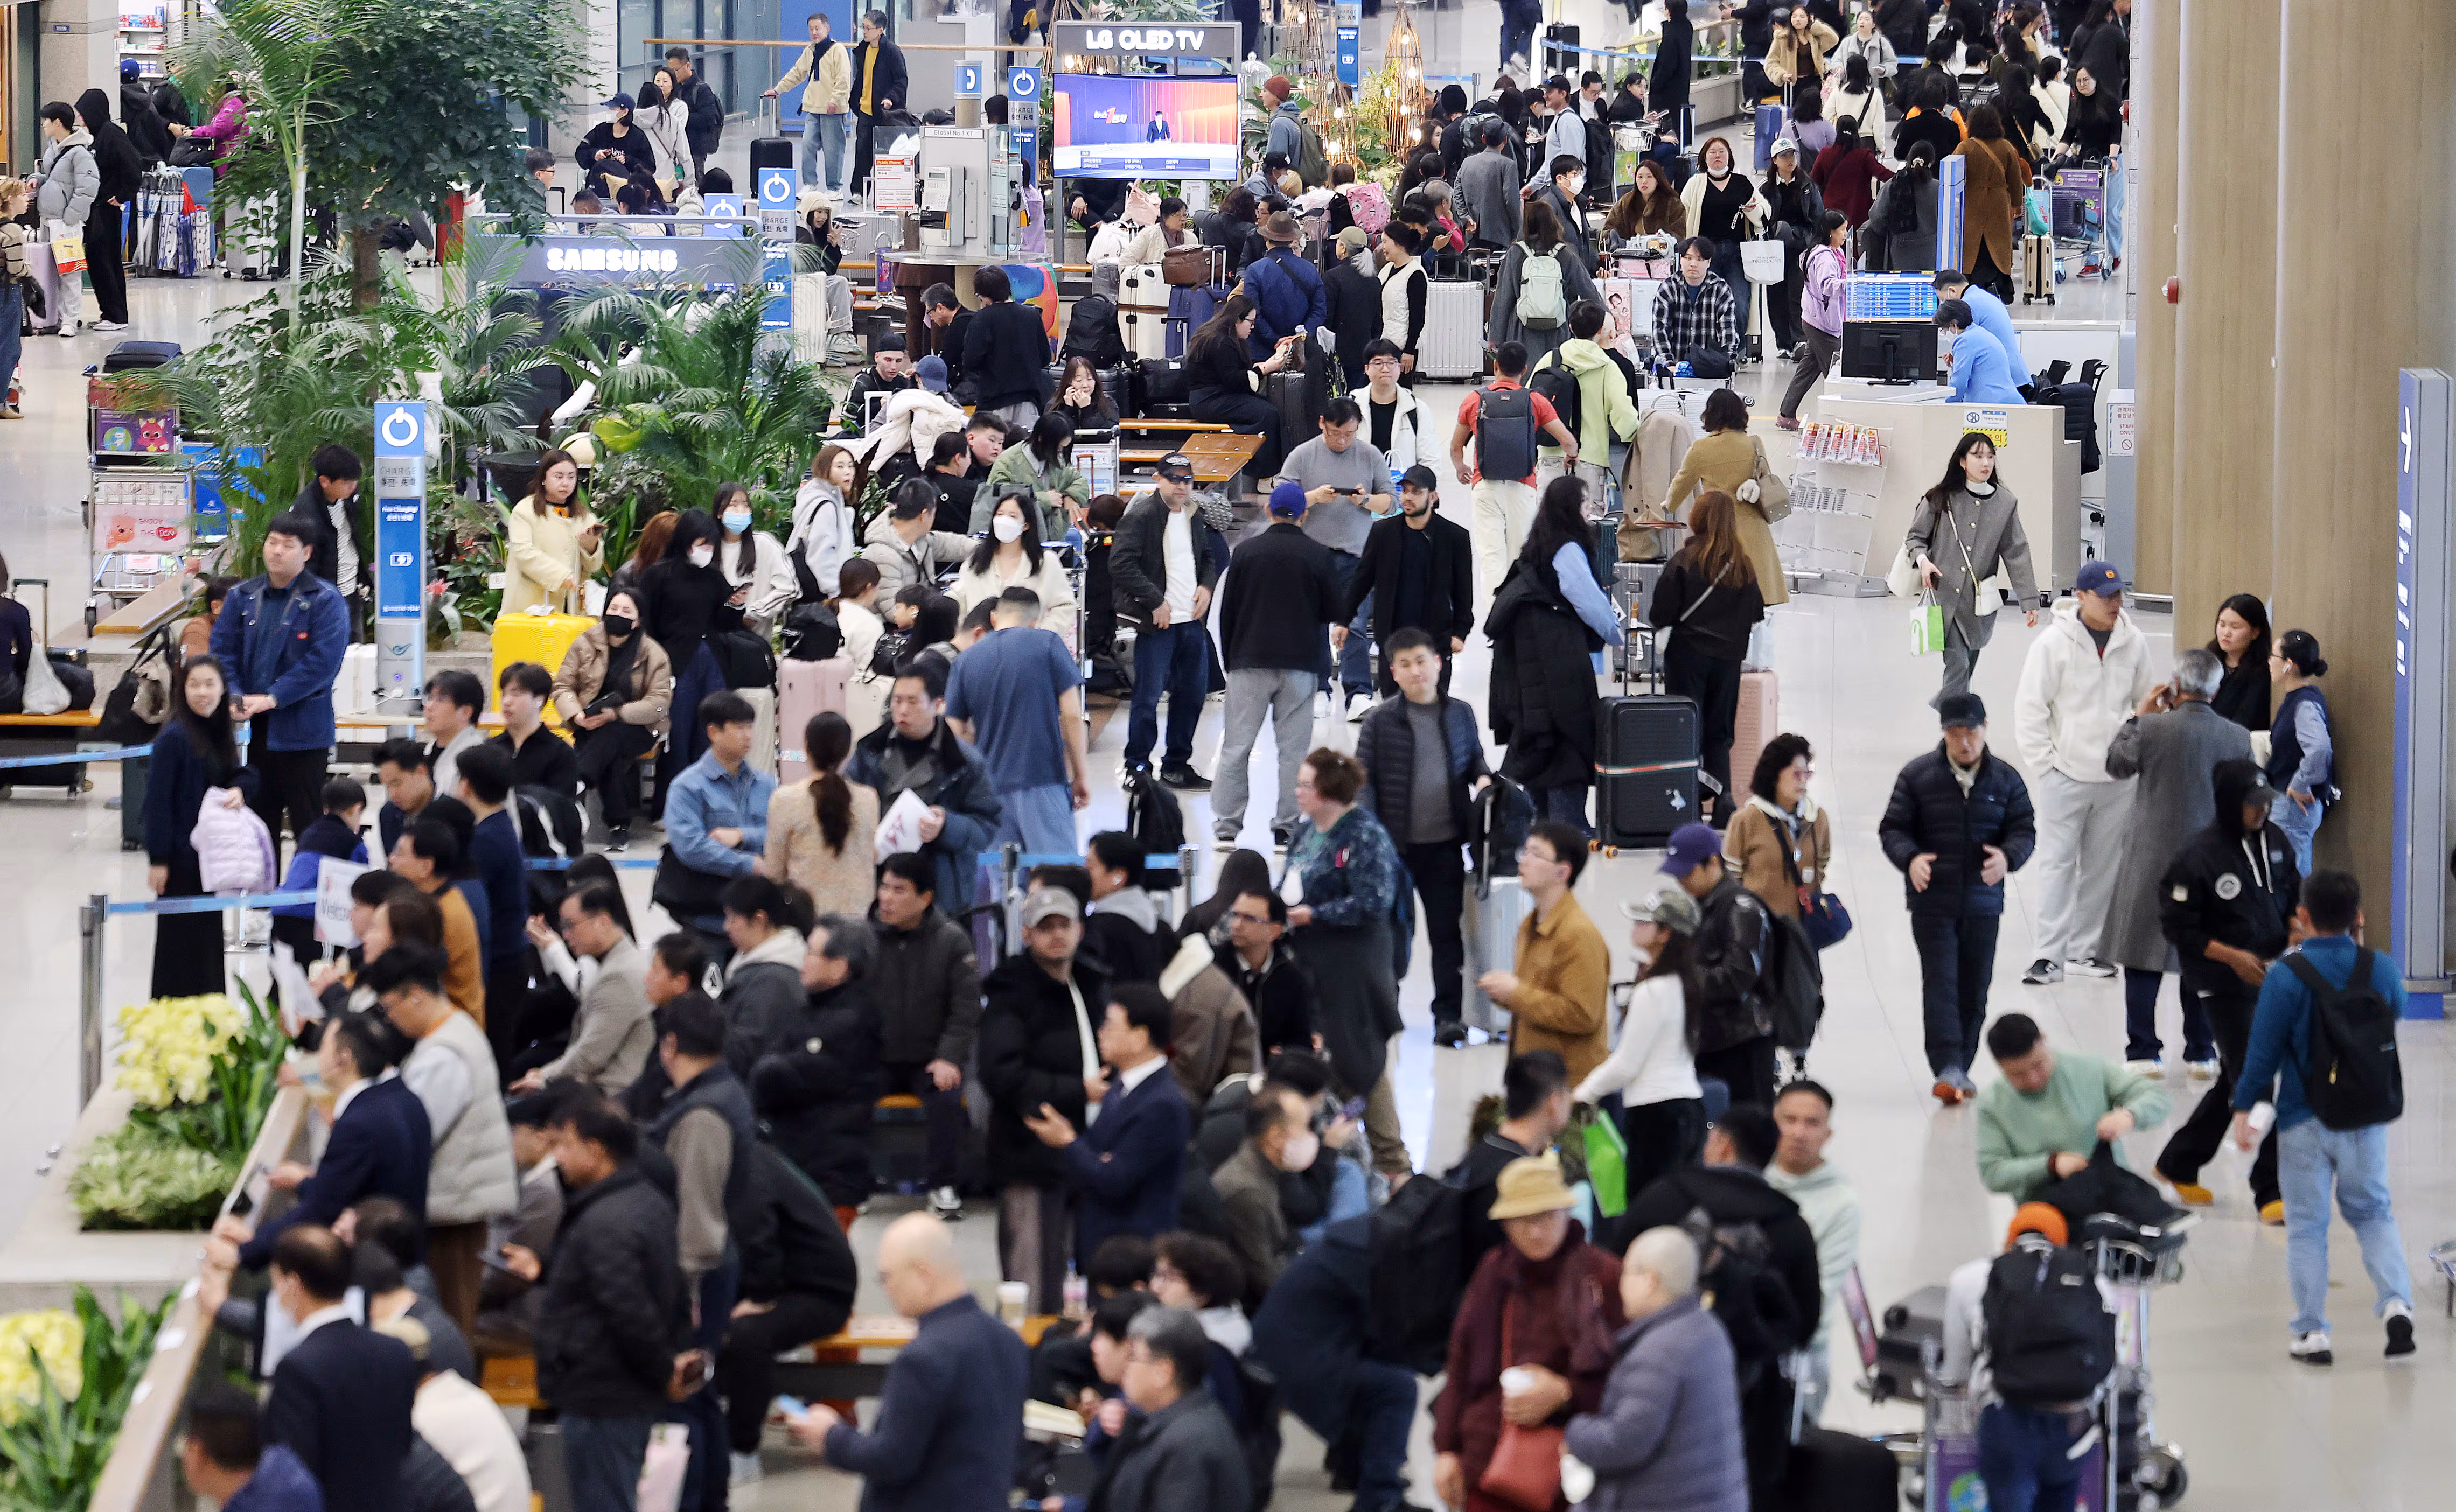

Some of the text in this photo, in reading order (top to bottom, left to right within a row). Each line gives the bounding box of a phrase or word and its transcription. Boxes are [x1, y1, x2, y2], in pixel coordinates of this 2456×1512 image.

[1086, 29, 1205, 51] LG OLED TV
[547, 248, 679, 271] SAMSUNG
[380, 467, 416, 475] CHARGE
